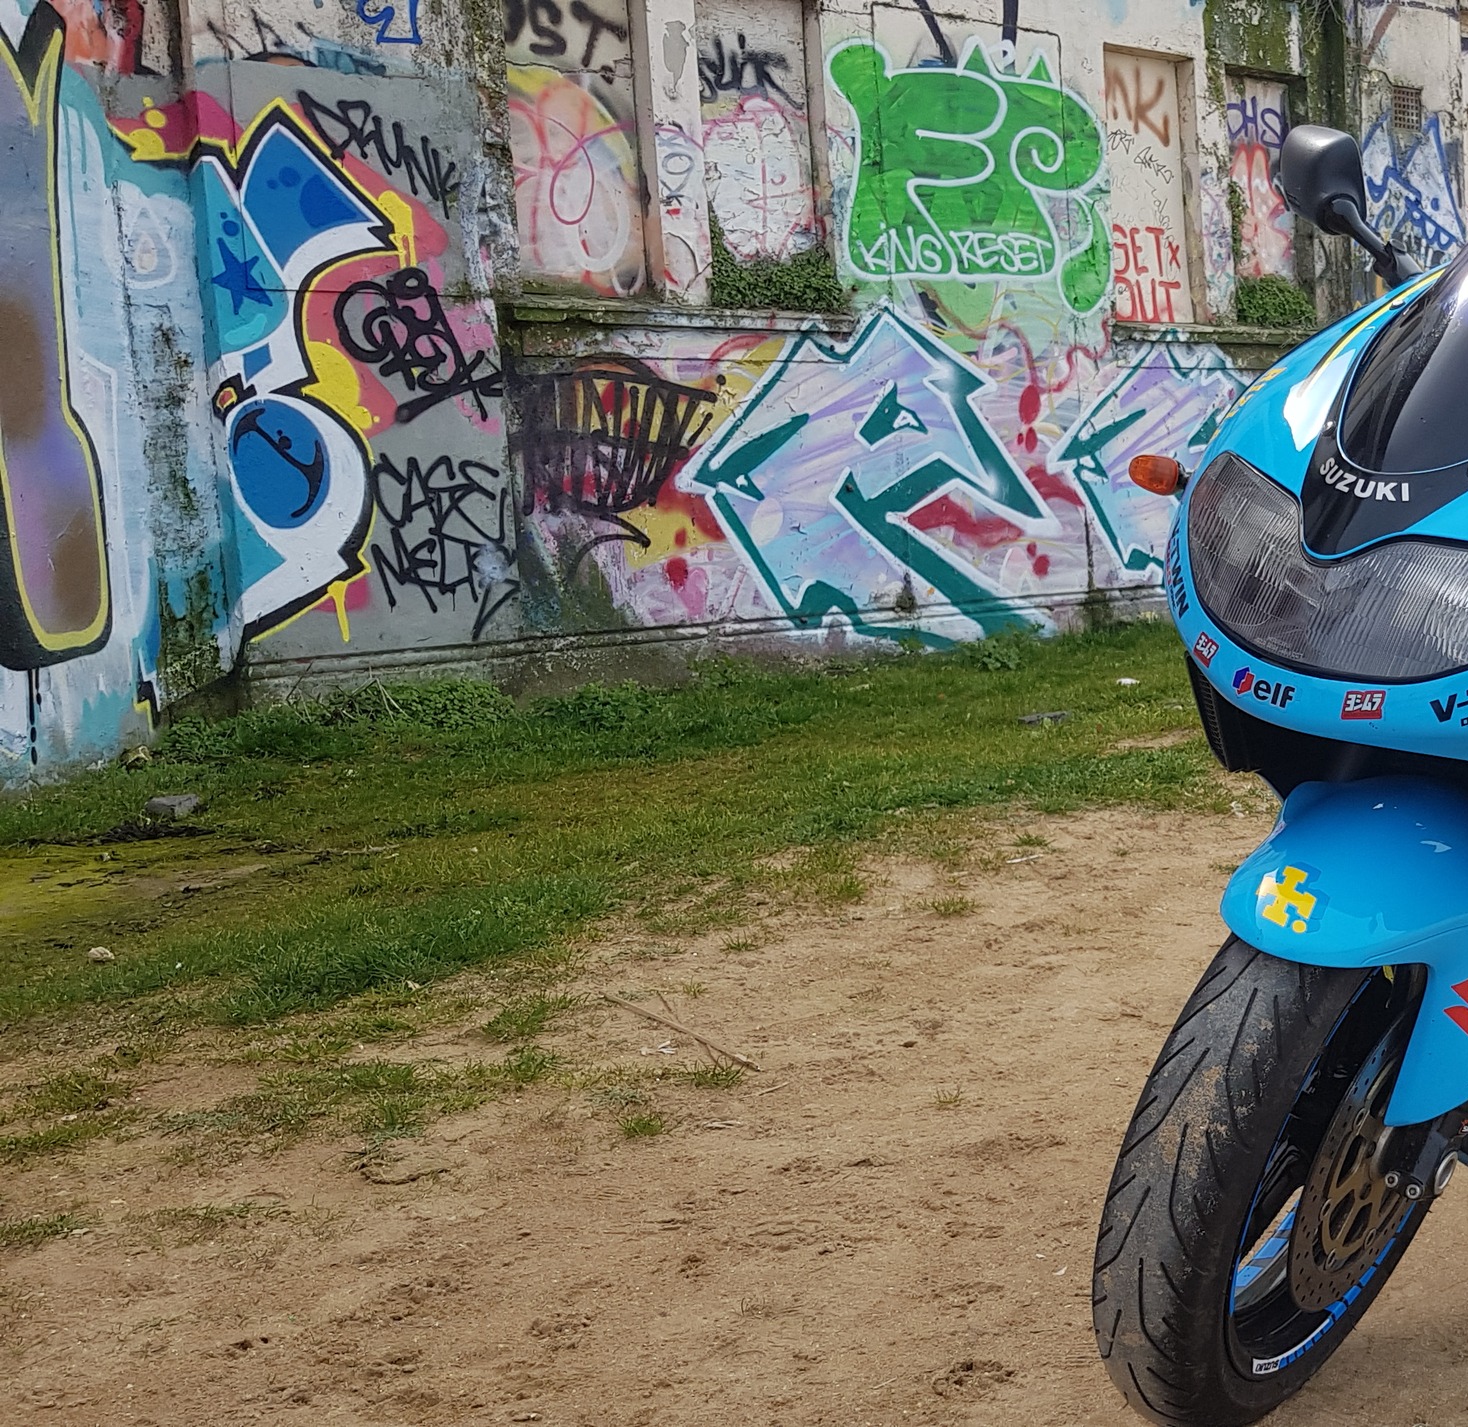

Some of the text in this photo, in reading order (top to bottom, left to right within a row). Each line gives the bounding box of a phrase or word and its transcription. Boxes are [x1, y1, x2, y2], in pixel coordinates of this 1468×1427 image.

[296, 88, 460, 221] DRUNK
[855, 222, 1053, 274] KING RESET
[1319, 457, 1410, 502] SUZUKI
[1253, 678, 1296, 709] elf
[1344, 692, 1383, 712] ヨシムラ
